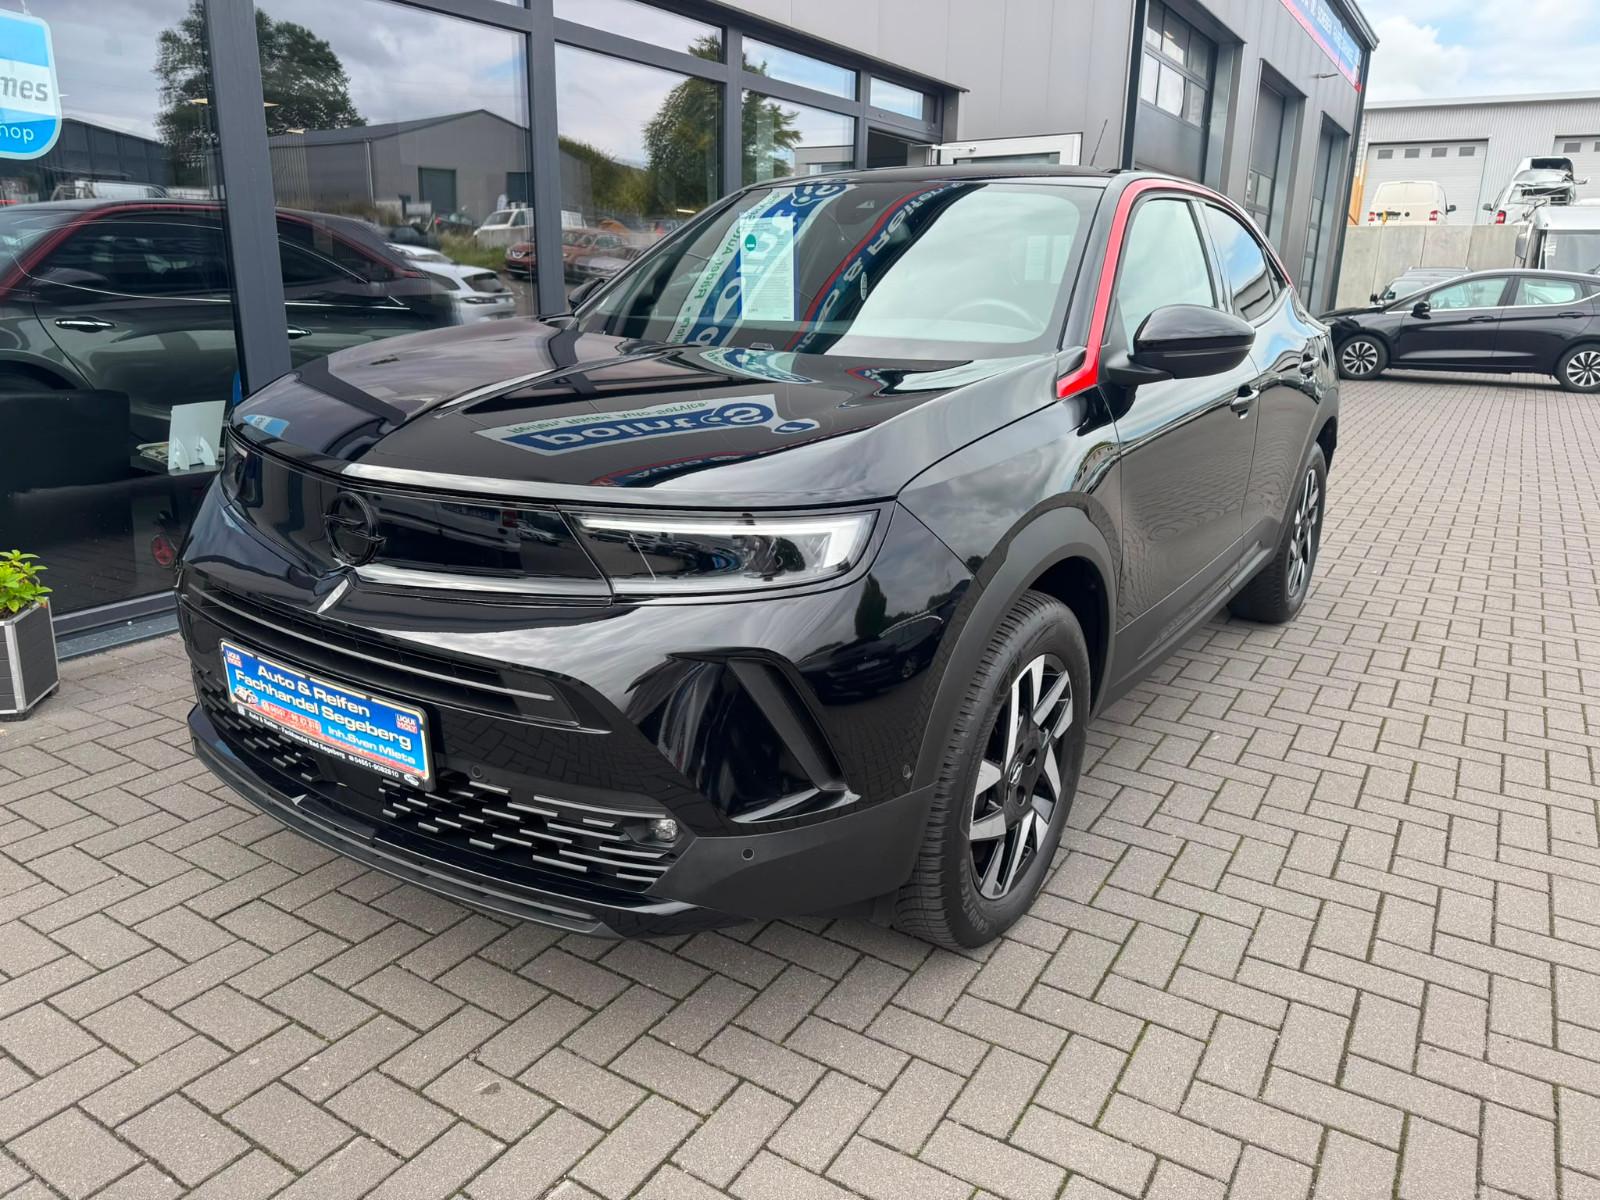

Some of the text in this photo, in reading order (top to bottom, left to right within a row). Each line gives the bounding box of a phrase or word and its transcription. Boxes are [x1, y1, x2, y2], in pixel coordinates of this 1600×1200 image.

[234, 668, 319, 714] Fachhandel
[322, 704, 412, 750] Segeberg
[257, 664, 370, 717] Auto & Reifen
